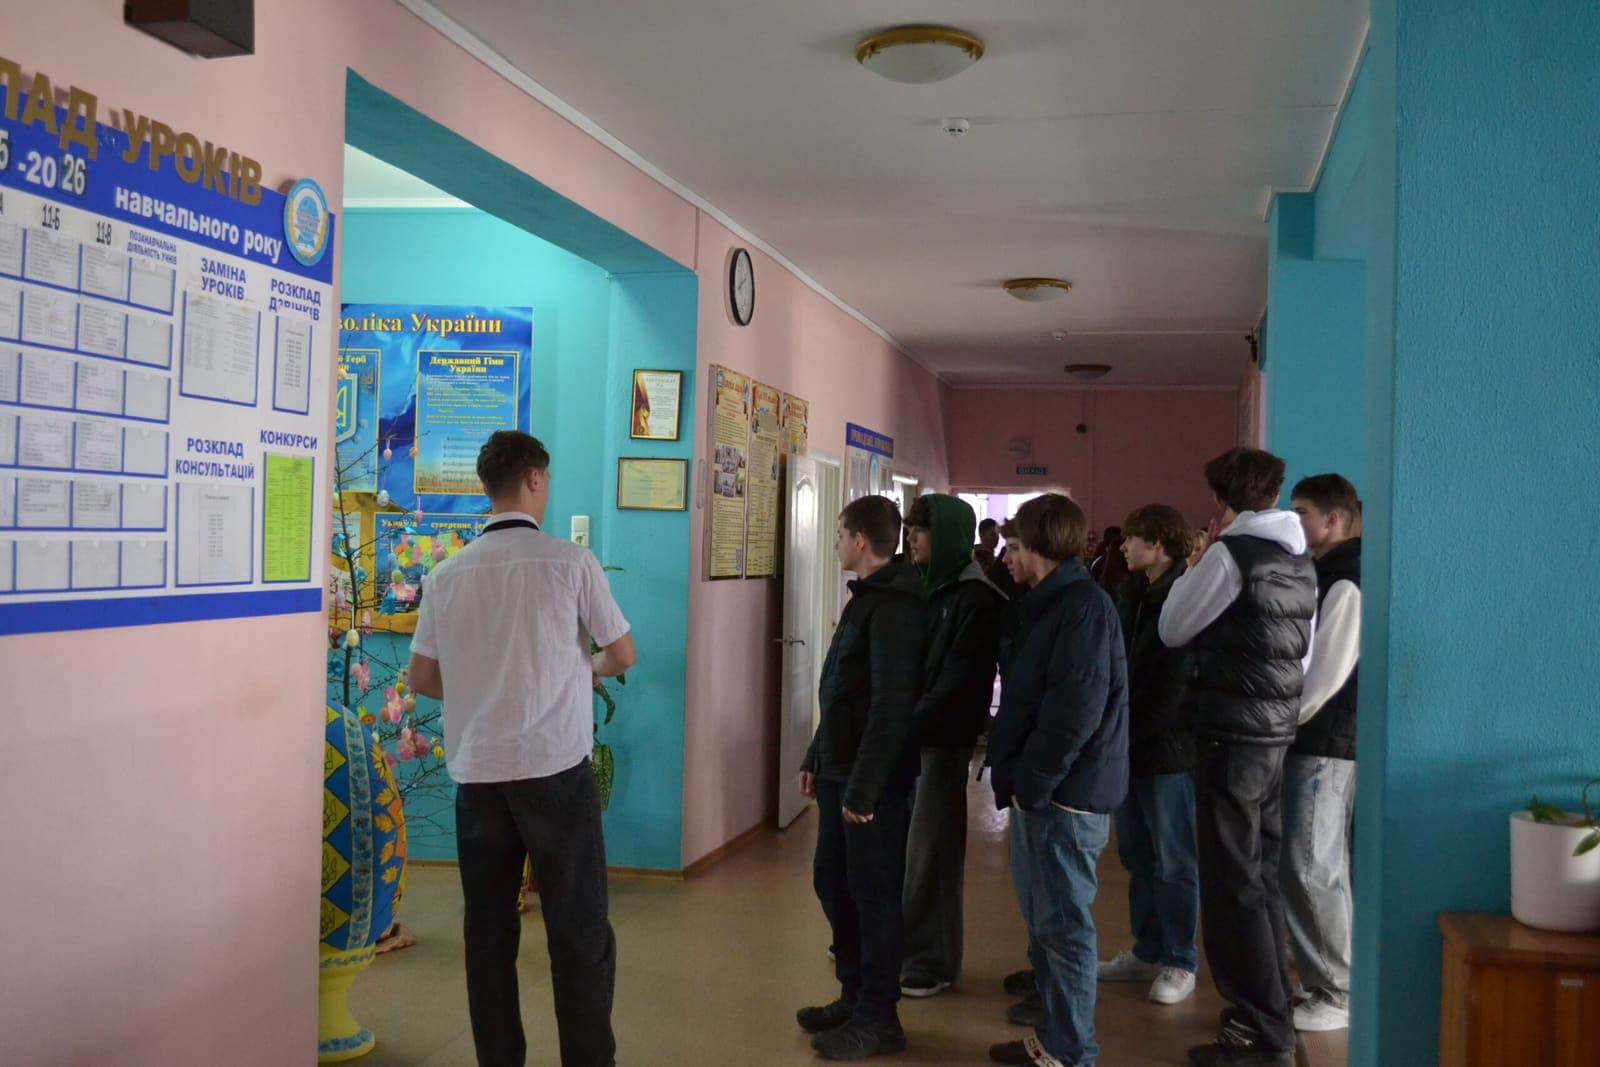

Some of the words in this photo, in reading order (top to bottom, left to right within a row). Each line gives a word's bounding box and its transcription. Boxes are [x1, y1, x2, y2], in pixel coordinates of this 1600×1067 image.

[122, 108, 262, 206] УРОКІВ
[41, 203, 61, 231] 11-Б
[96, 220, 112, 246] 11-В
[115, 186, 239, 245] навчального
[243, 229, 282, 265] року
[201, 258, 246, 283] ЗАМІНА
[202, 276, 245, 300] УРОКІВ
[271, 278, 321, 308] РОЗКЛАД
[410, 313, 502, 338] України
[186, 437, 244, 458] РОЗКЛАД
[260, 429, 318, 450] КОНКУРСИ
[175, 459, 255, 481] КОНСУЛЬТАЦІЙ
